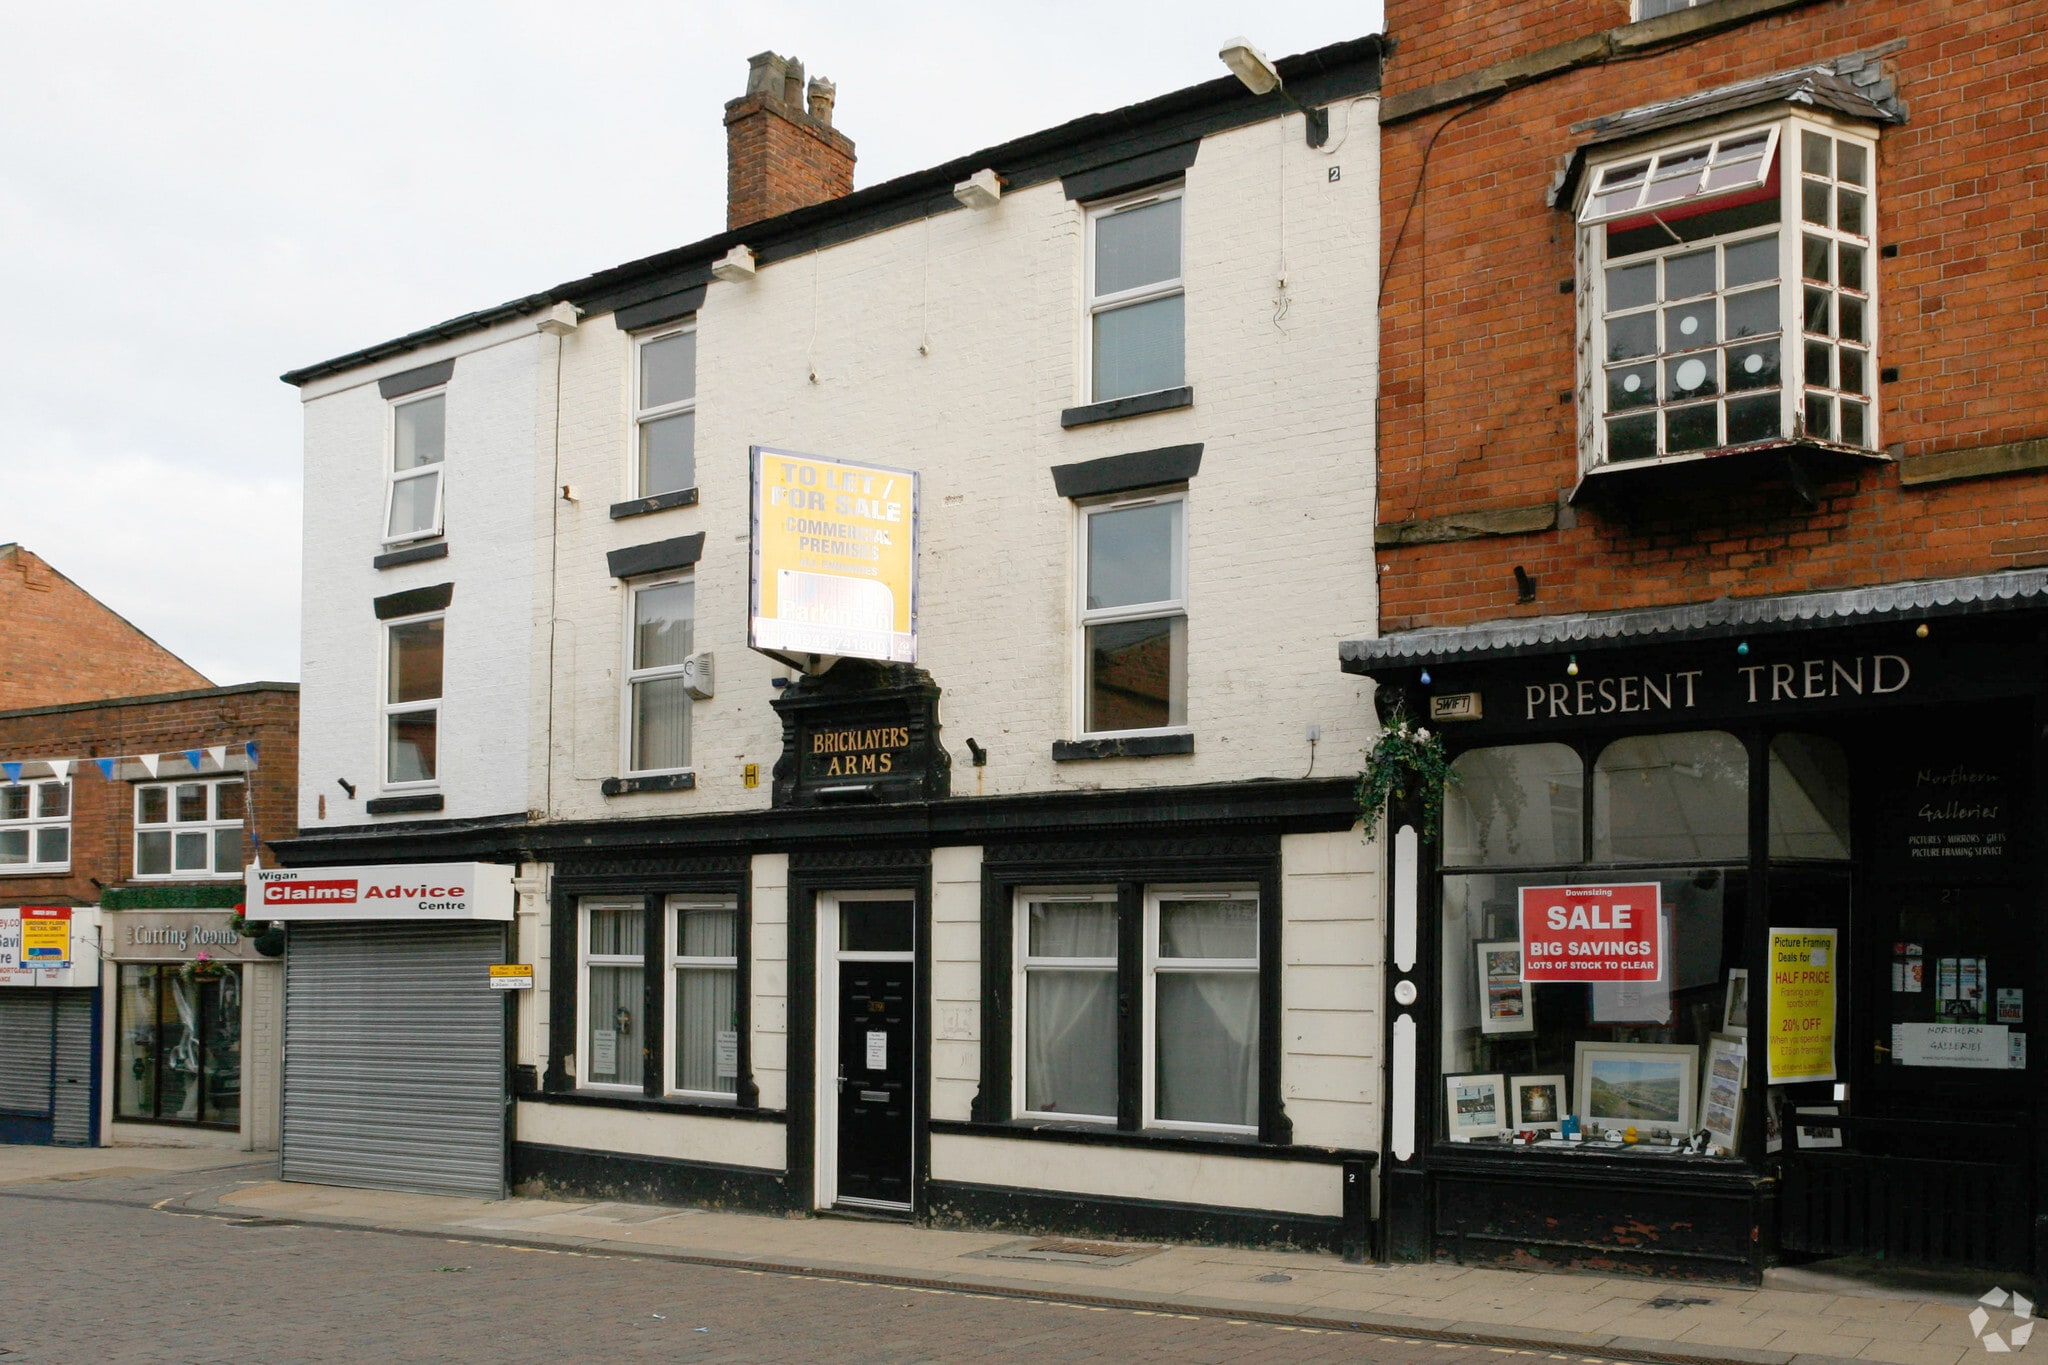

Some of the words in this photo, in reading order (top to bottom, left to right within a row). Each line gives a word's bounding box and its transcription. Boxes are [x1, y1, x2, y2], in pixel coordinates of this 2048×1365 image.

[1330, 167, 1339, 180] 2
[781, 463, 816, 486] TO
[827, 469, 875, 494] LET
[882, 479, 894, 499] /
[771, 485, 825, 512] FOR
[835, 494, 901, 522] SALE
[786, 516, 892, 545] COMMERCIAL
[800, 536, 879, 561] PREMISES
[1526, 670, 1703, 720] PRESENT
[1738, 655, 1910, 703] TREND
[1436, 696, 1469, 711] SWIFT
[813, 727, 909, 753] BRICKLAYERS
[827, 753, 892, 776] ARMS
[1916, 763, 2000, 788] Northern
[1918, 800, 1998, 823] Galleries
[1908, 835, 1941, 845] PICTURES
[1947, 834, 1981, 844] MIRRORS
[1986, 832, 2007, 844] GIFTS
[1912, 848, 1940, 857] PICTURE
[1941, 847, 1973, 858] FRAMING
[258, 872, 298, 881] Wigan
[265, 886, 357, 901] Claims
[364, 884, 465, 899] Advice
[1565, 889, 1613, 897] Downsizing
[418, 901, 466, 910] Centre
[1546, 904, 1632, 930] SALE
[134, 925, 187, 951] Cutting
[192, 925, 237, 945] Rooms
[1774, 937, 1801, 948] Picture
[1803, 937, 1831, 950] Framing
[1530, 941, 1563, 956] BIG
[1568, 941, 1651, 956] SAVINGS
[1778, 952, 1798, 962] Deals
[1799, 952, 1810, 962] for
[1528, 961, 1552, 970] LOTS
[1555, 961, 1567, 970] OF
[1570, 961, 1602, 970] STOCK
[1604, 961, 1618, 970] TO
[1621, 961, 1654, 970] CLEAR
[1775, 971, 1800, 984] HALF
[1802, 971, 1830, 984] PRICE
[1780, 987, 1803, 998] Framing
[1787, 999, 1803, 1008] sports
[1782, 1018, 1800, 1032] 20%
[1802, 1018, 1822, 1031] OFF
[1927, 1026, 1983, 1035] NORTHERN
[1770, 1035, 1788, 1044] When
[1800, 1035, 1819, 1045] spend
[1930, 1041, 1981, 1051] GALLERIES
[1800, 1045, 1824, 1056] framing
[1349, 1173, 1355, 1183] 2
